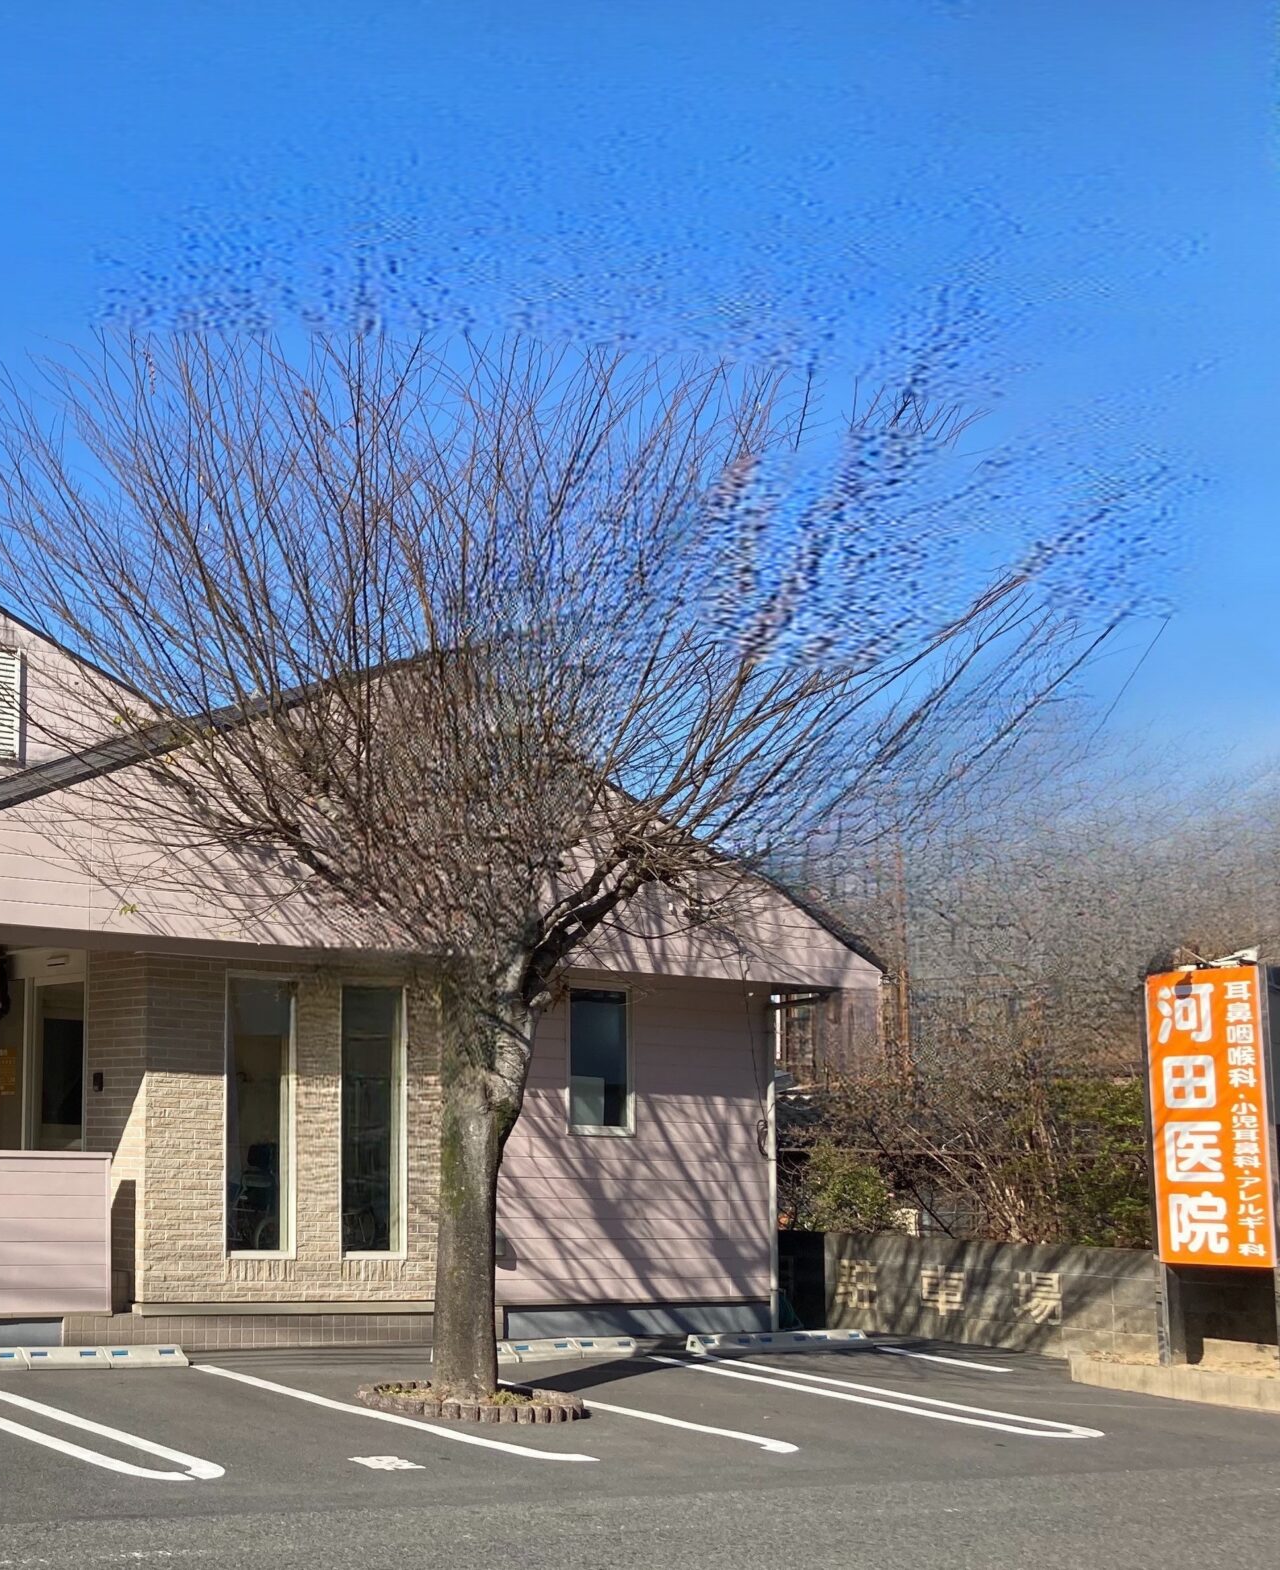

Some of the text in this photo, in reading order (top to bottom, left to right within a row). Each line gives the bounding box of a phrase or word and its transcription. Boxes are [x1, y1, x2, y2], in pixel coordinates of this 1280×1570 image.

[1157, 983, 1230, 1254] 河田医院
[835, 1258, 1063, 1325] 駐車場
